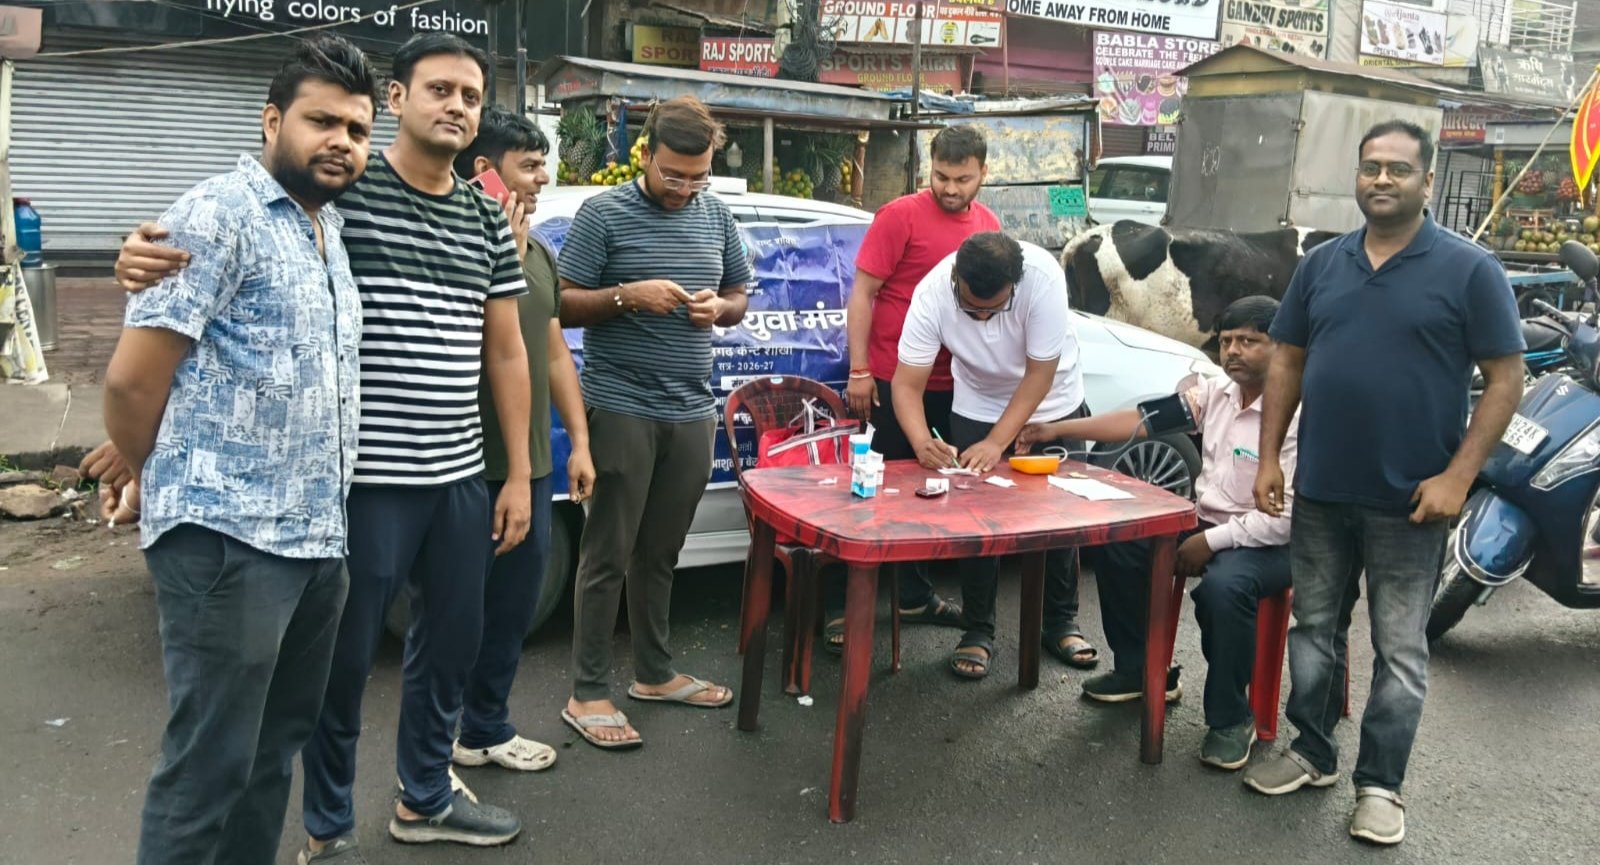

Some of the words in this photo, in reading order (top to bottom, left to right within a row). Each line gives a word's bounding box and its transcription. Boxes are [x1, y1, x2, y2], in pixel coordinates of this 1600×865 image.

[288, 0, 362, 23] colors
[373, 6, 398, 26] of
[411, 7, 489, 34] fashion
[823, 1, 885, 16] GROUND
[1008, 0, 1041, 15] OME
[1045, 2, 1086, 21] AWAY
[1089, 7, 1128, 25] FROM
[1131, 12, 1171, 31] HOME
[1227, 1, 1277, 25] GANDHI
[1276, 8, 1324, 33] SPORTS
[702, 42, 725, 61] RAJ
[729, 43, 779, 63] SPORTS
[1097, 33, 1159, 49] BABLA
[1164, 37, 1221, 55] STORE
[641, 45, 697, 61] SPOR
[1095, 46, 1154, 59] CELEBRATE
[1159, 50, 1179, 60] THE
[821, 55, 902, 72] SPORTS
[1118, 58, 1134, 67] CAKE
[1134, 59, 1161, 69] MARRIAGE
[1161, 60, 1176, 69] CAKE
[857, 73, 894, 83] GROUND
[896, 73, 925, 83] FLOR
[742, 311, 797, 342] युवा
[737, 361, 774, 371] 2026-27
